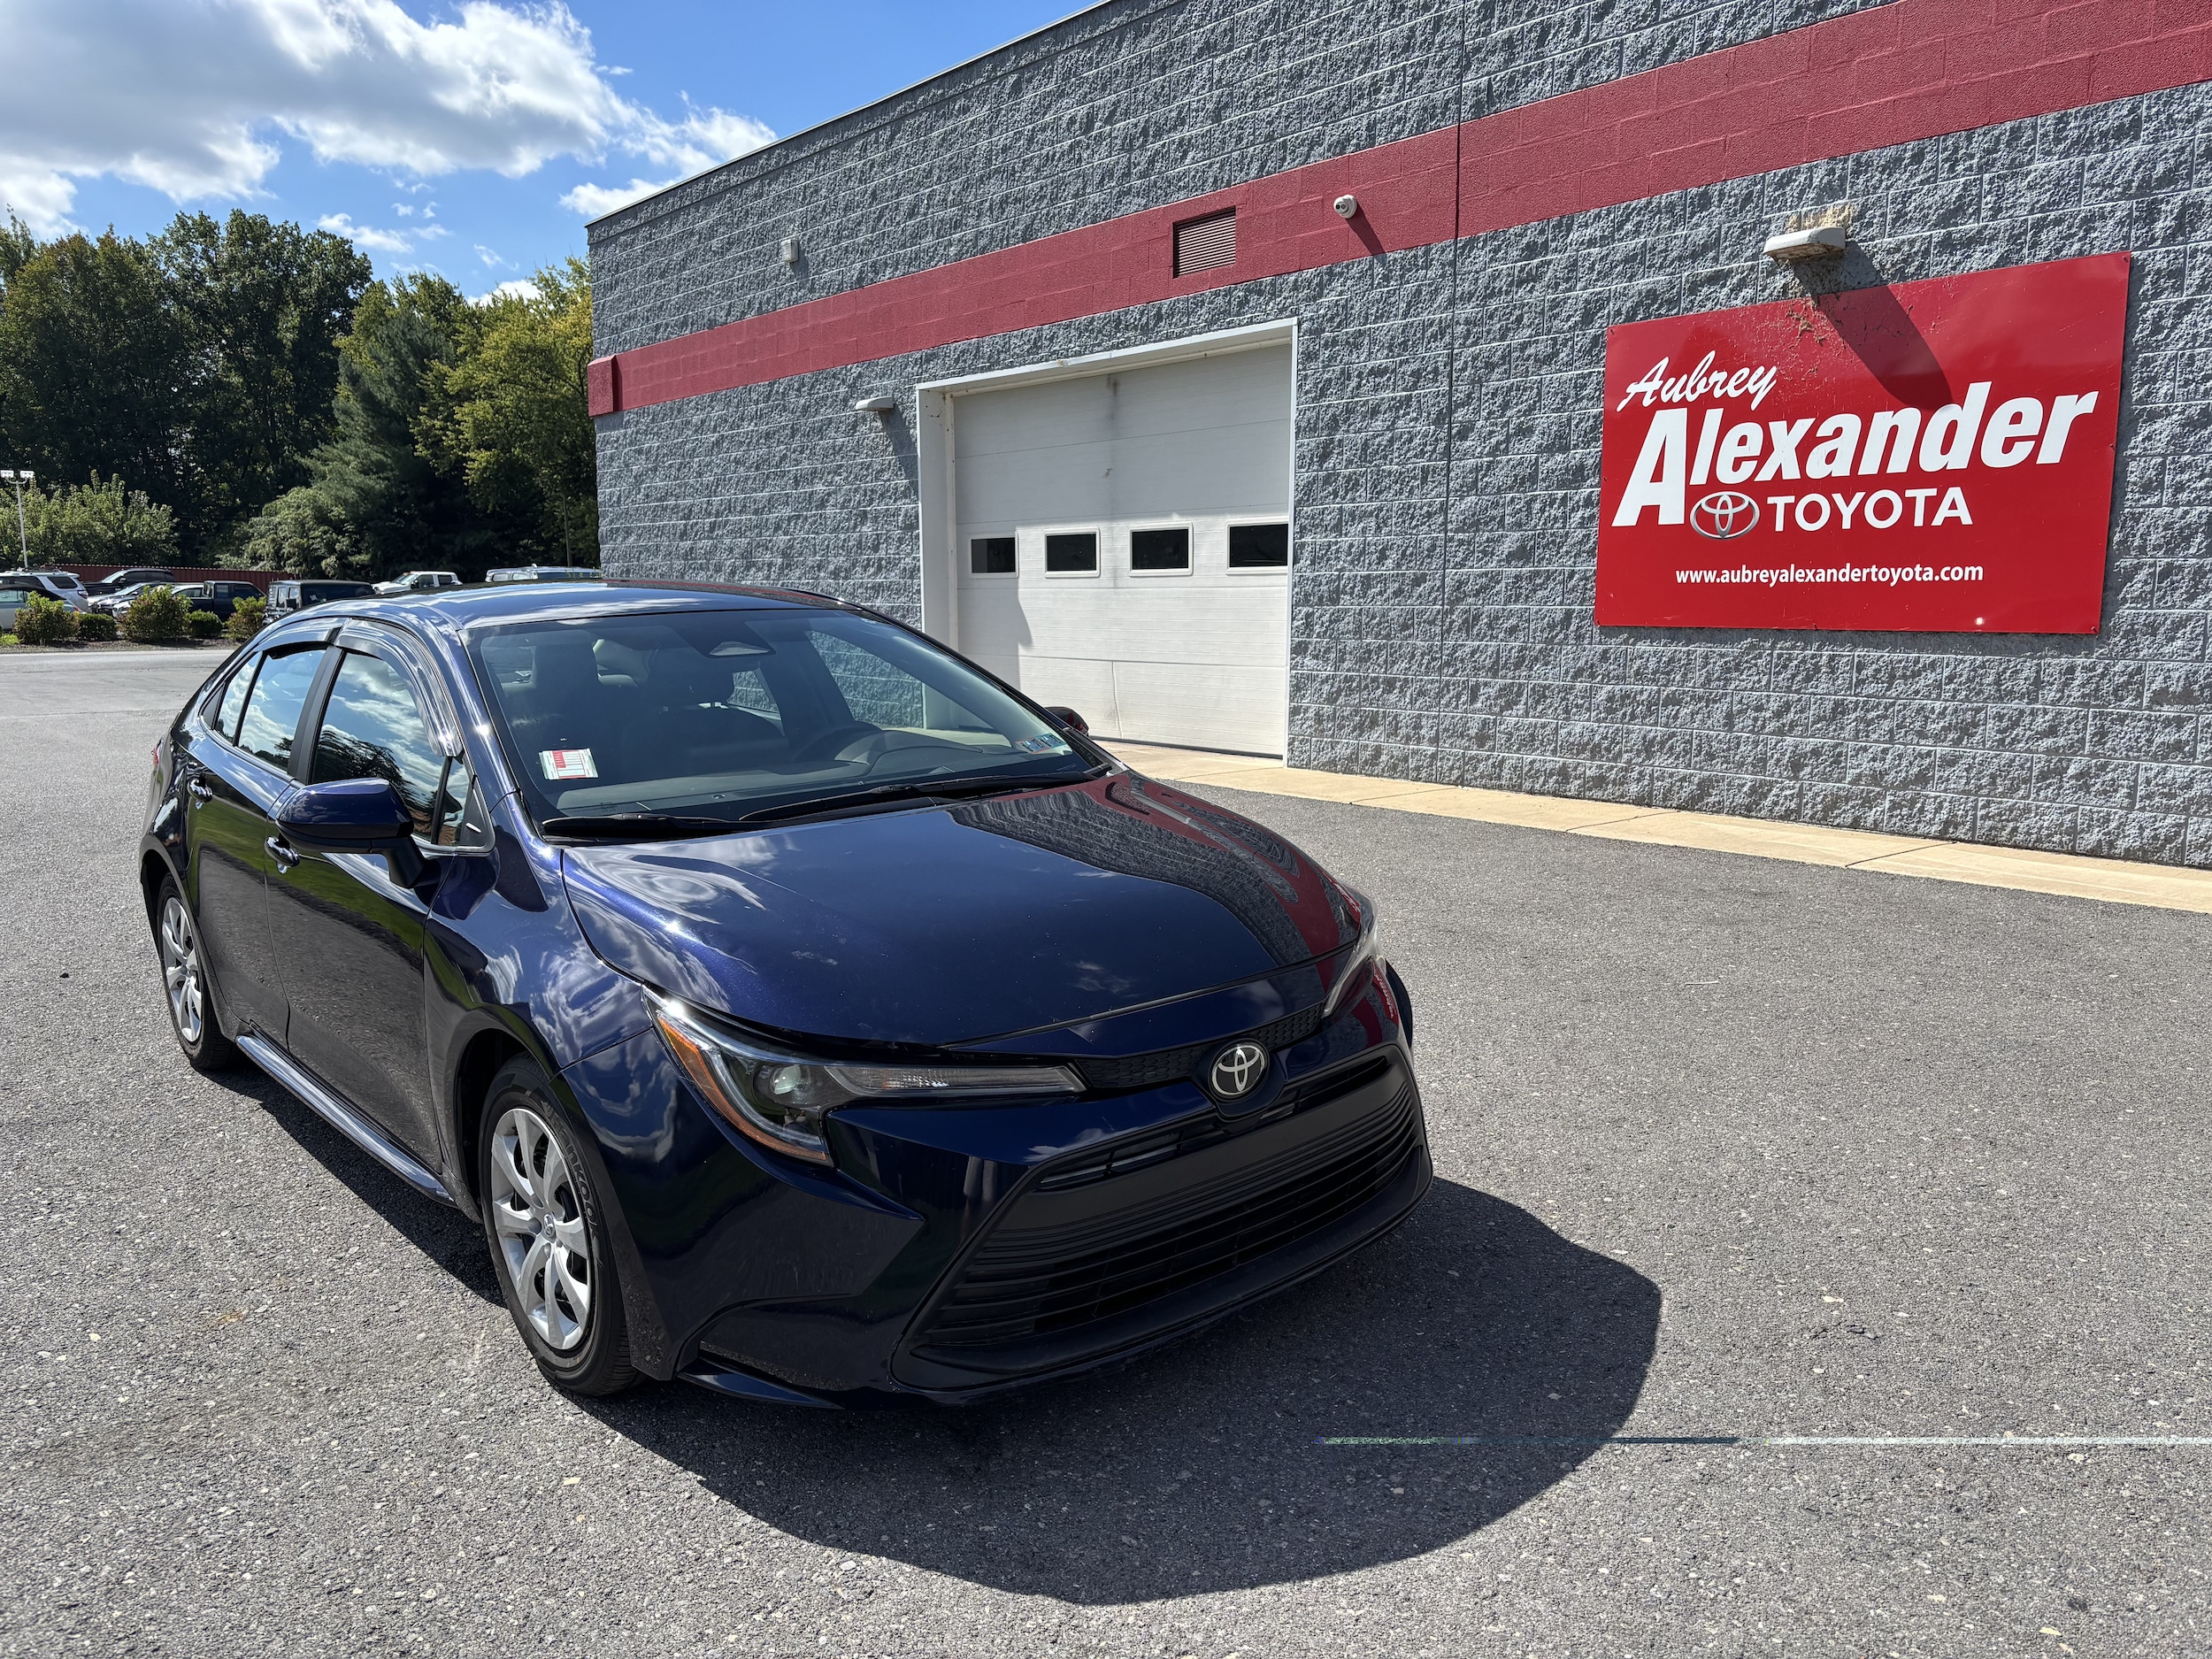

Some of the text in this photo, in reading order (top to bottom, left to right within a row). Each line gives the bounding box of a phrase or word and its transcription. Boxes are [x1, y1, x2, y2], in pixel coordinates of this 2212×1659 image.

[1616, 350, 1778, 412] Aubrey
[1611, 380, 2100, 527] Alexander
[1766, 486, 1973, 532] TOYOTA
[1675, 562, 1984, 588] www.aubreyalexandertoyota.com
[549, 1112, 599, 1240] Hankook
